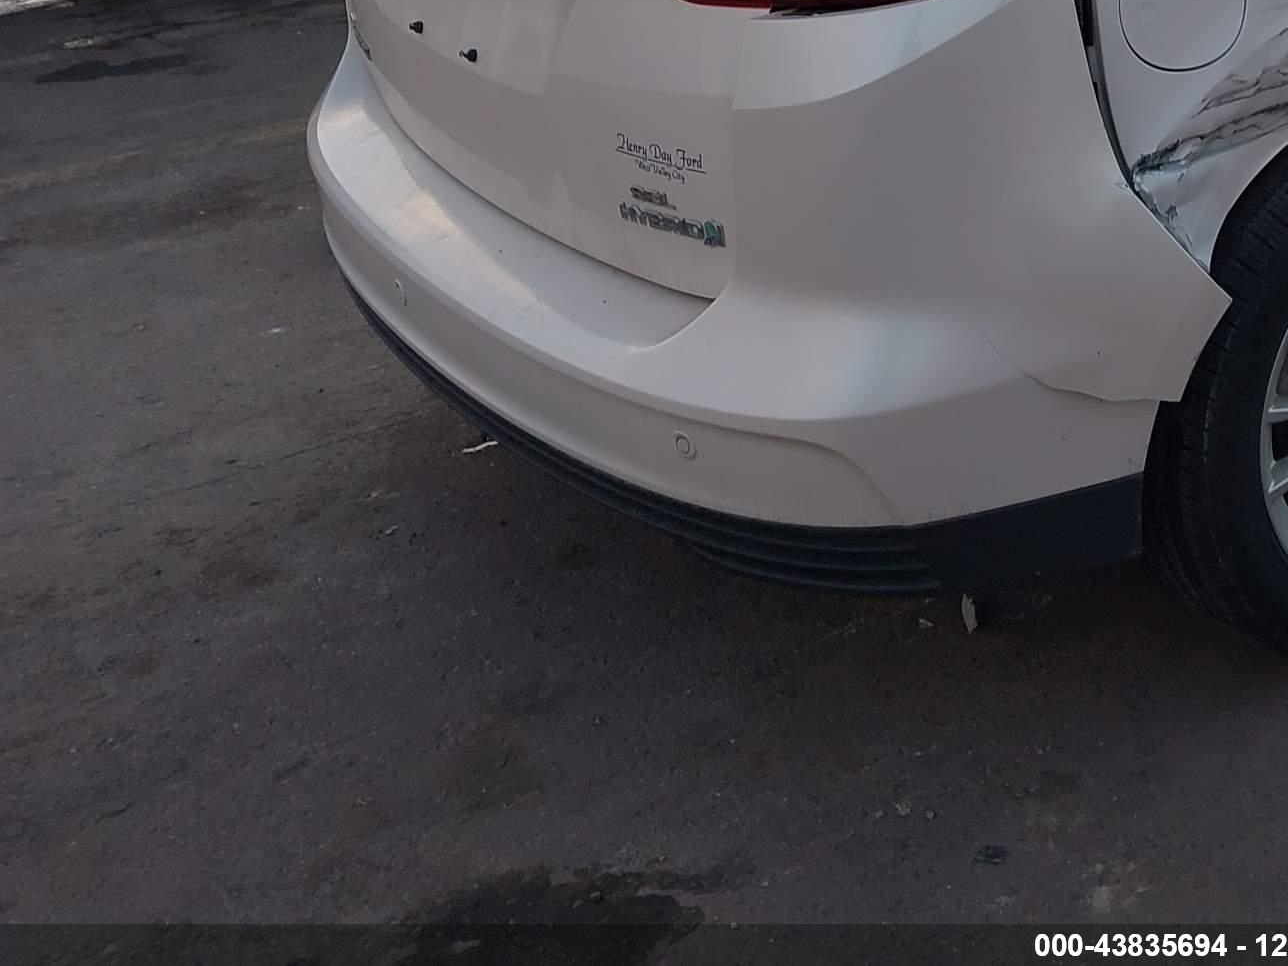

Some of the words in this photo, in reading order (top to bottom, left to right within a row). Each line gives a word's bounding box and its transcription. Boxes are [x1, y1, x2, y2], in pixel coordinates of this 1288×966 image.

[616, 132, 648, 160] Henry
[649, 144, 673, 168] Day
[675, 148, 703, 171] Ford
[671, 169, 686, 185] City
